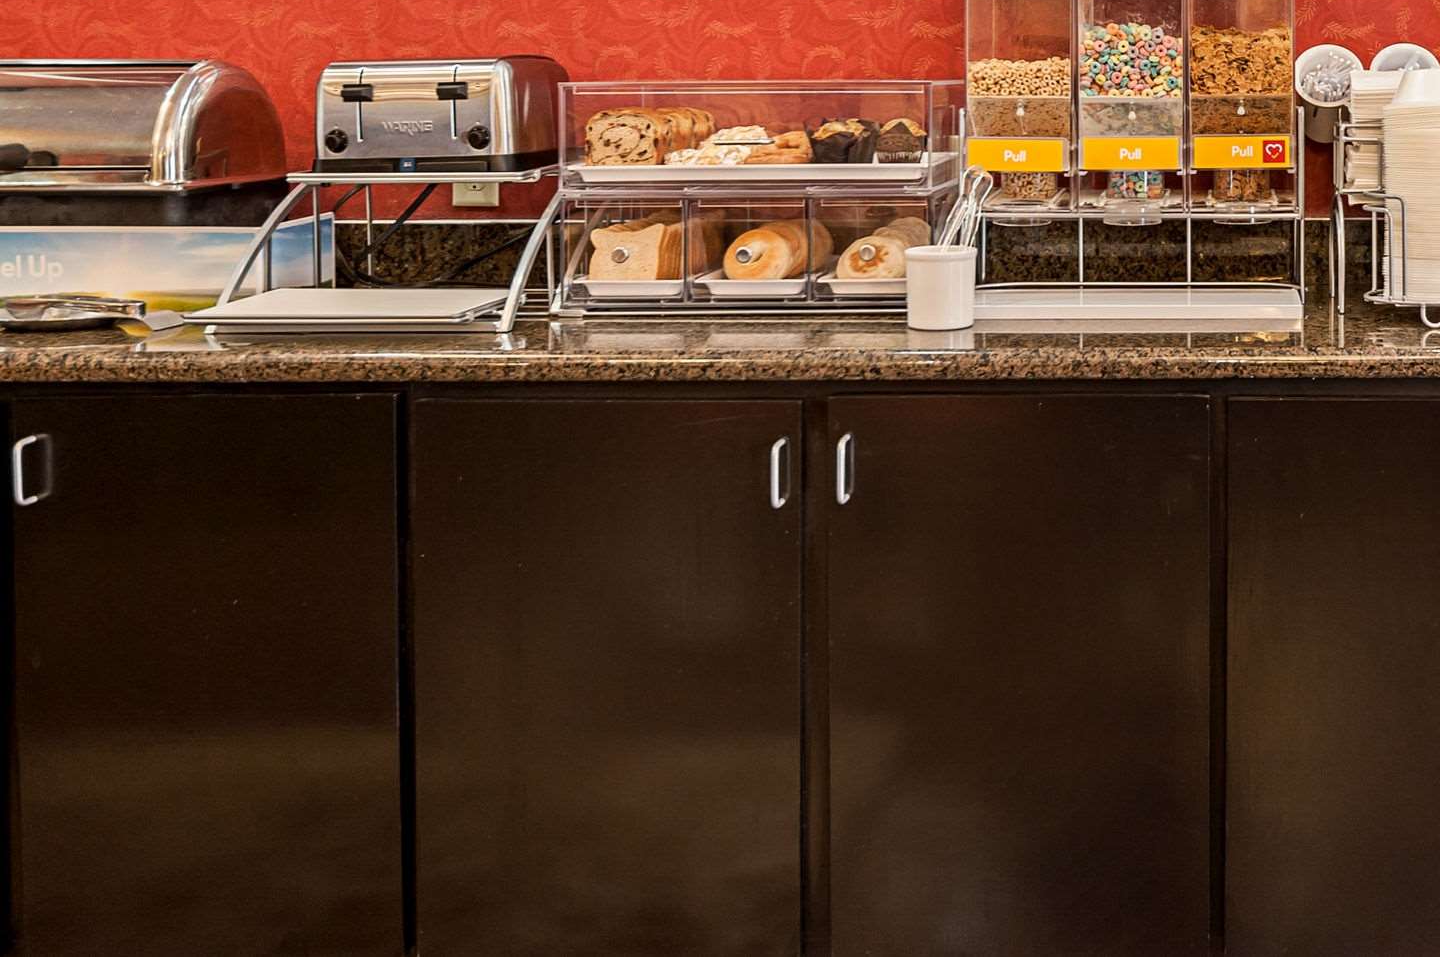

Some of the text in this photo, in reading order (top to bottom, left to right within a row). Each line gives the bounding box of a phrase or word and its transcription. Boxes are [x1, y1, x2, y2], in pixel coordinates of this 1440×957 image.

[1003, 149, 1027, 163] Pull
[1119, 148, 1142, 161] Pull
[1231, 145, 1254, 158] Pull
[28, 254, 65, 284] Up
